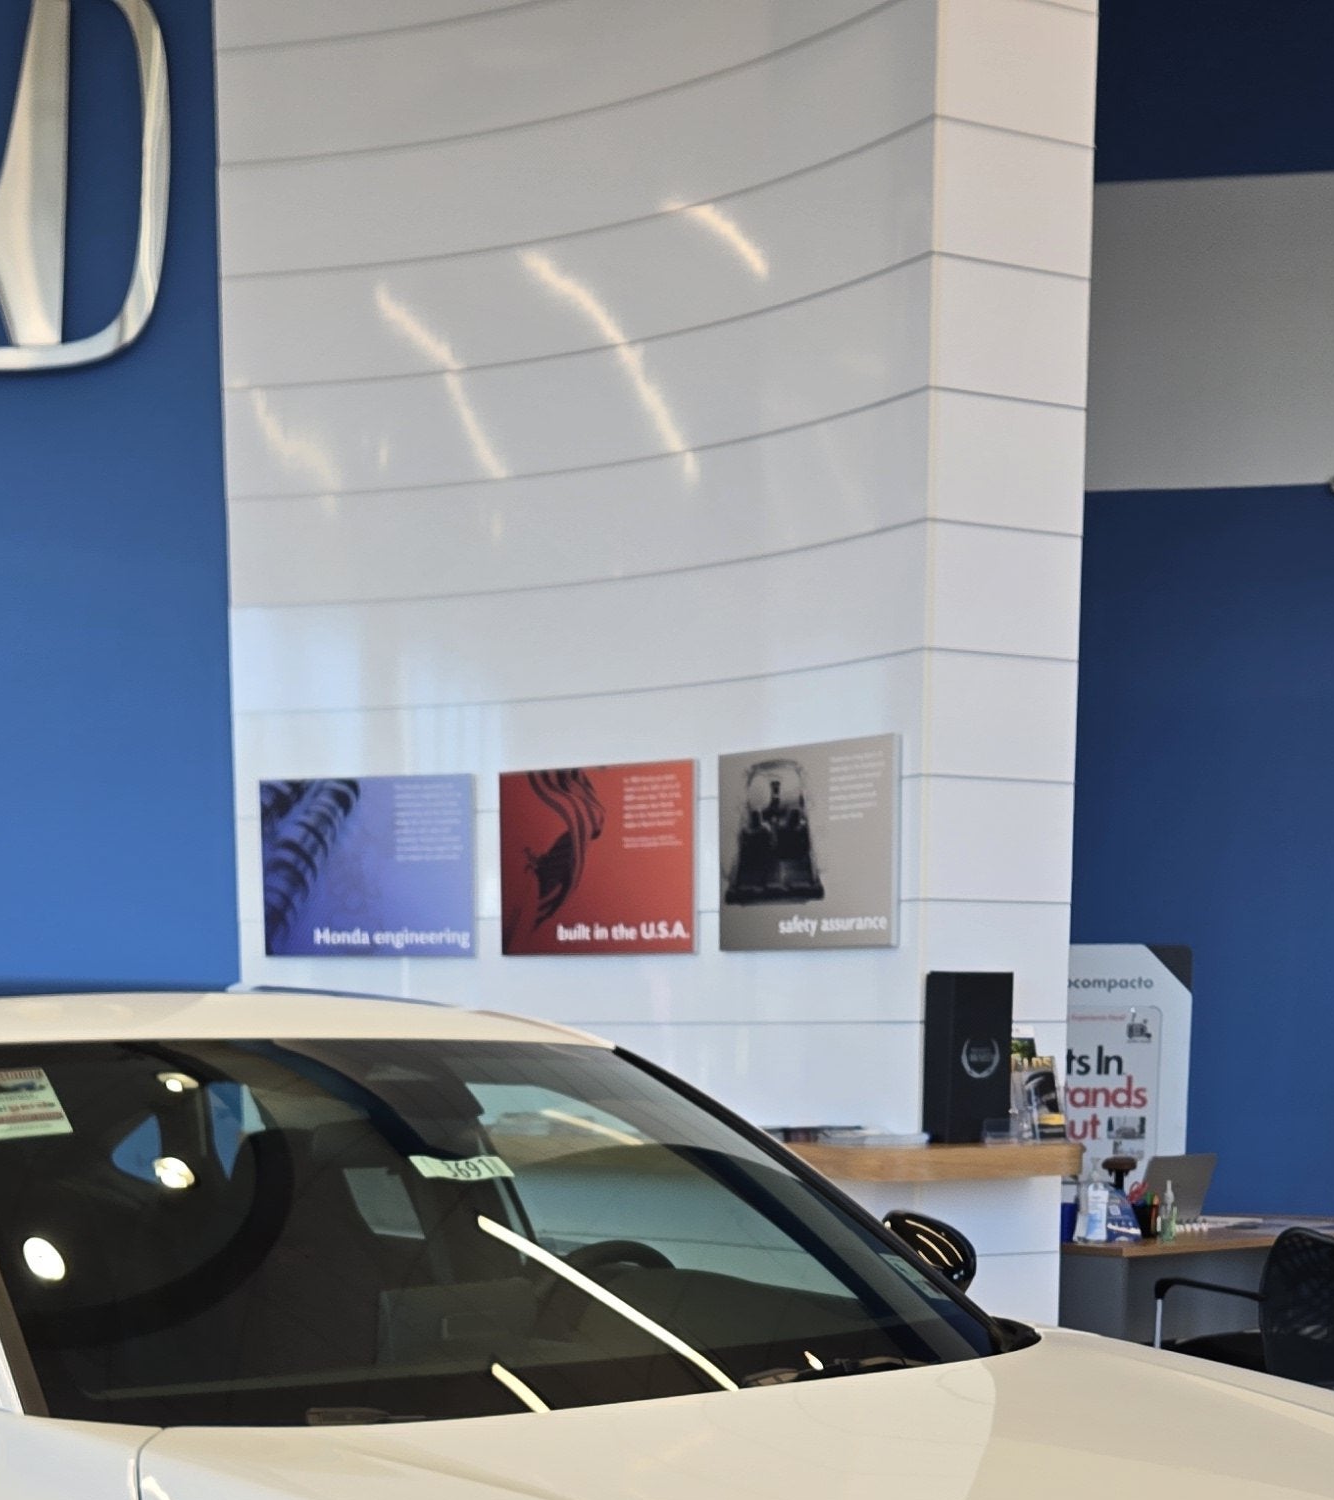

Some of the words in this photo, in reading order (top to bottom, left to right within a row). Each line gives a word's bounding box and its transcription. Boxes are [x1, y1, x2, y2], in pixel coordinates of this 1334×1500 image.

[556, 922, 591, 941] built
[593, 922, 609, 940] in
[611, 922, 638, 941] the
[640, 919, 690, 939] U.S.A.
[778, 915, 818, 937] safety
[820, 915, 887, 932] assurance
[313, 927, 370, 945] Honda
[372, 927, 471, 949] engineering
[1067, 1048, 1091, 1076] ts
[1067, 1114, 1101, 1140] ut
